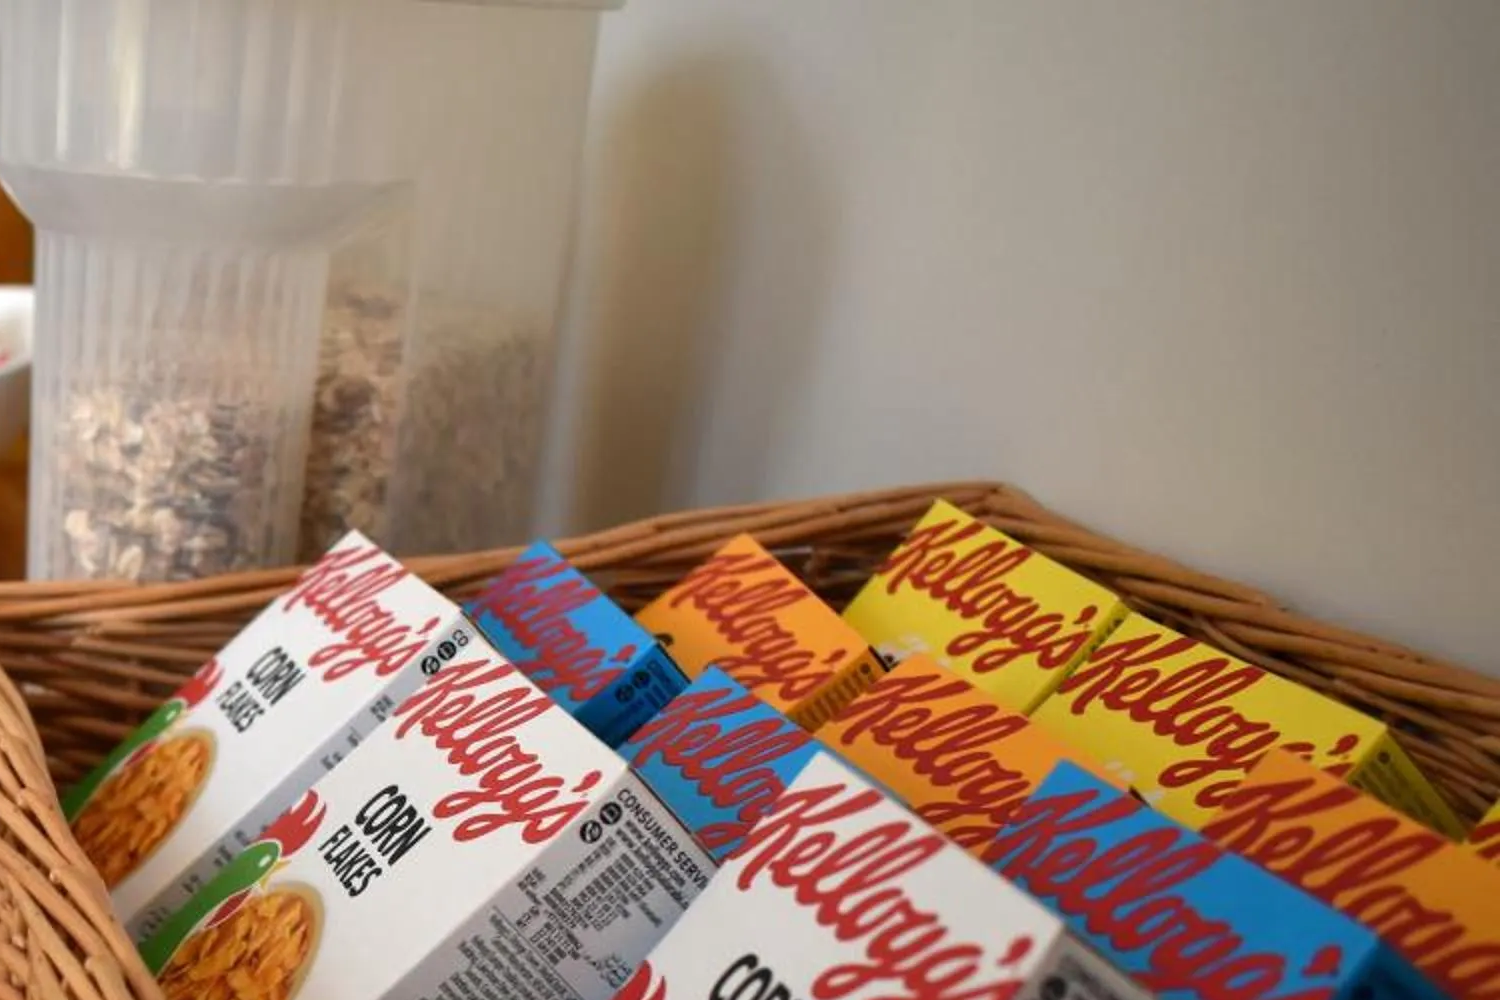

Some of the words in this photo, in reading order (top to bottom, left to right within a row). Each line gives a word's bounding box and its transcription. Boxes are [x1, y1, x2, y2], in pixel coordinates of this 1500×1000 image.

[283, 546, 441, 683] Kellogg's
[469, 556, 637, 702] Kellogg's
[669, 553, 847, 702] Kellogg's
[880, 519, 1097, 673] Kellogg's
[216, 681, 265, 733] FLAKES
[246, 646, 307, 708] CORN
[393, 660, 602, 844] Kellogg's
[628, 688, 815, 850] Kello
[833, 674, 1031, 848] Kellog
[318, 825, 383, 897] FLAKES
[355, 785, 433, 866] CORN
[617, 789, 680, 856] CONSUMER
[673, 851, 710, 891] SERVI
